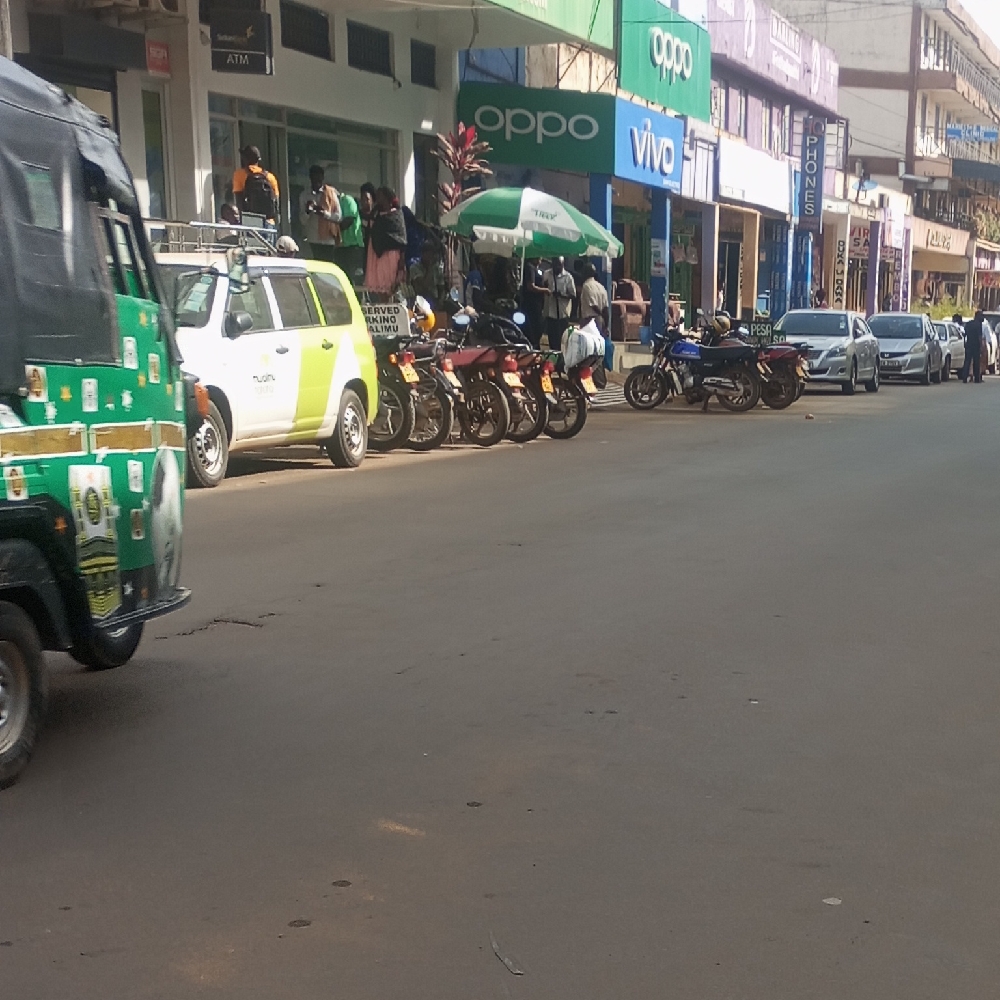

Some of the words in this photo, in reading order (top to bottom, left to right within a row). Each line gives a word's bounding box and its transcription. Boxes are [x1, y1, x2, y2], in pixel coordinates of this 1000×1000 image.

[226, 53, 249, 65] ATM
[650, 26, 693, 84] oppo
[474, 105, 599, 144] oppo
[630, 117, 675, 176] vivo
[804, 135, 818, 216] PHONES
[362, 306, 400, 315] SERVED
[366, 315, 397, 324] RKING
[369, 325, 399, 333] ALIMU
[750, 323, 772, 337] PESA
